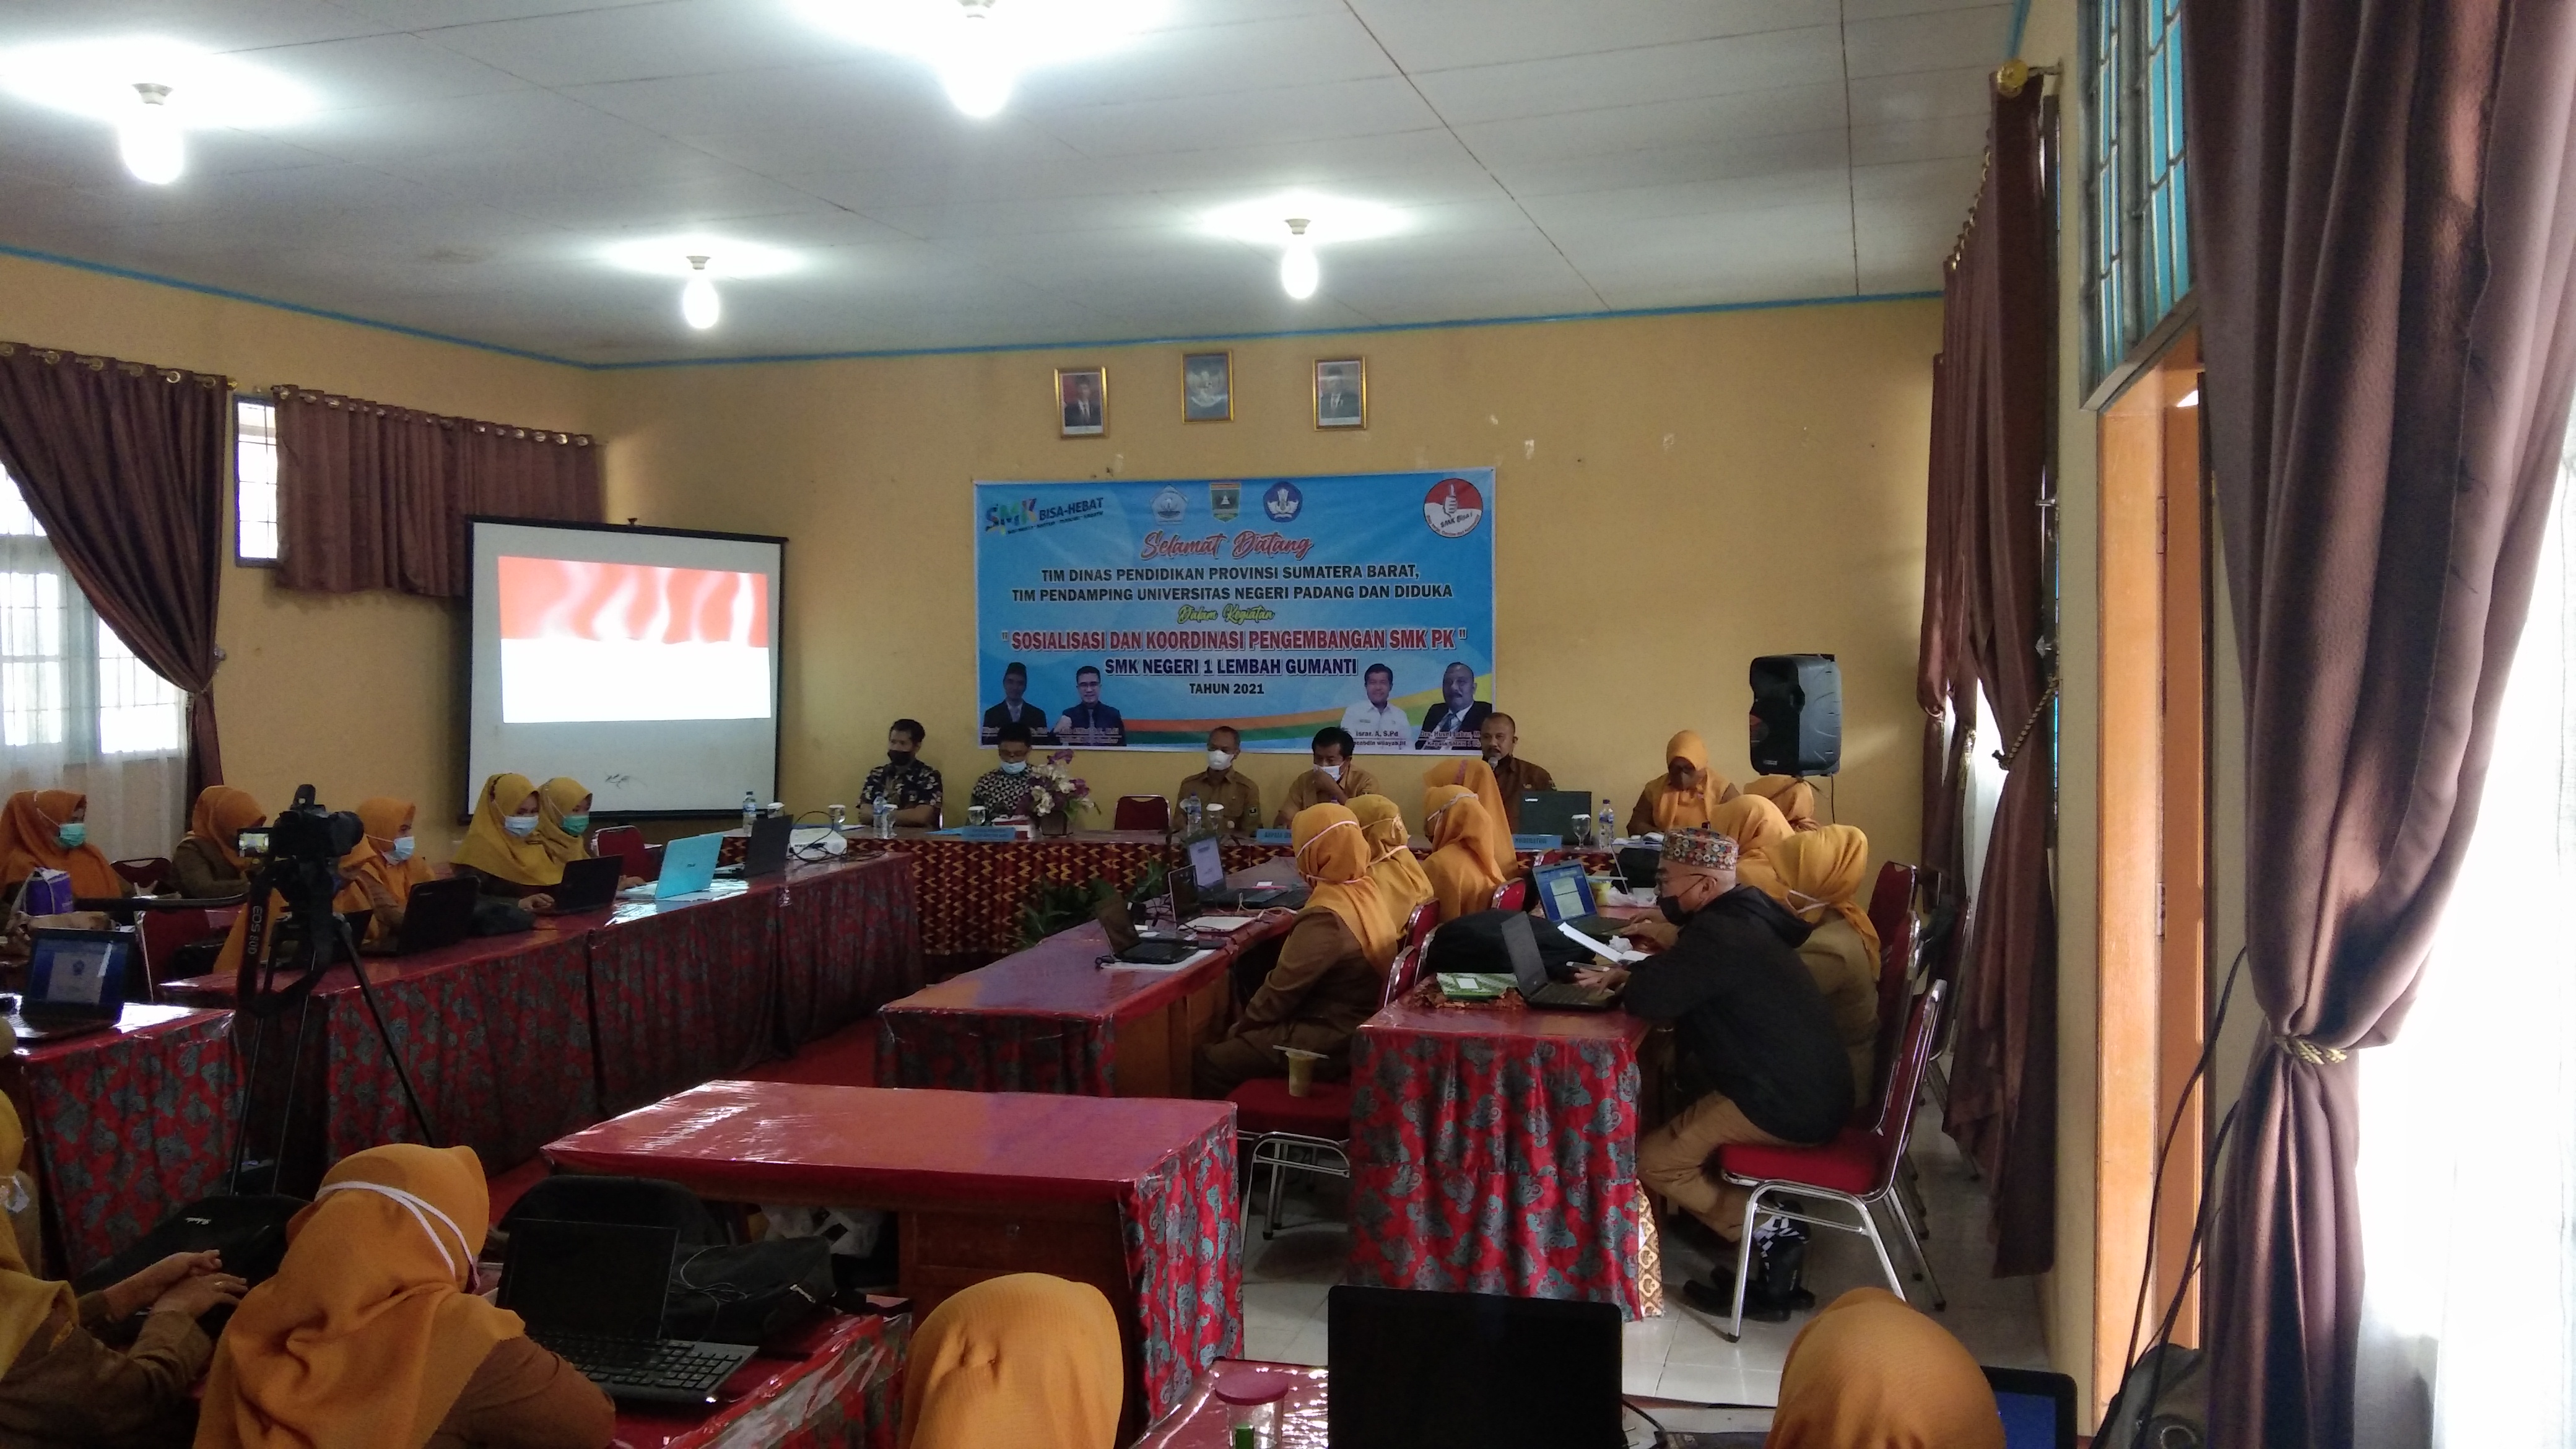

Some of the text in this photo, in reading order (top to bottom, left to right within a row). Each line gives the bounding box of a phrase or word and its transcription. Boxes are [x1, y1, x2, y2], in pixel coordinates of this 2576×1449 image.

[986, 497, 1103, 534] SMK BISA-HEBAT
[1141, 531, 1314, 560] Selamat Datang
[1042, 565, 1420, 582] TIM DINAS PENDIDIKAN PROVINSI SUMATERA BARAT,
[1012, 585, 1453, 601] TIM PENDAMPING UNIVERSITAS NEGERI PADANG DAN DIDUKA
[1178, 604, 1276, 624] Dalam Kegiatan
[1110, 631, 1142, 650] DAN
[1146, 630, 1245, 650] KOORDINASI
[1249, 630, 1385, 649] PENGEMBANGAN
[1389, 629, 1426, 648] SMK
[1105, 658, 1357, 674] SMK NEGERI 1 LEMBAH GUMANTI
[1190, 684, 1264, 694] TAHUN 2021
[251, 905, 263, 932] EOS
